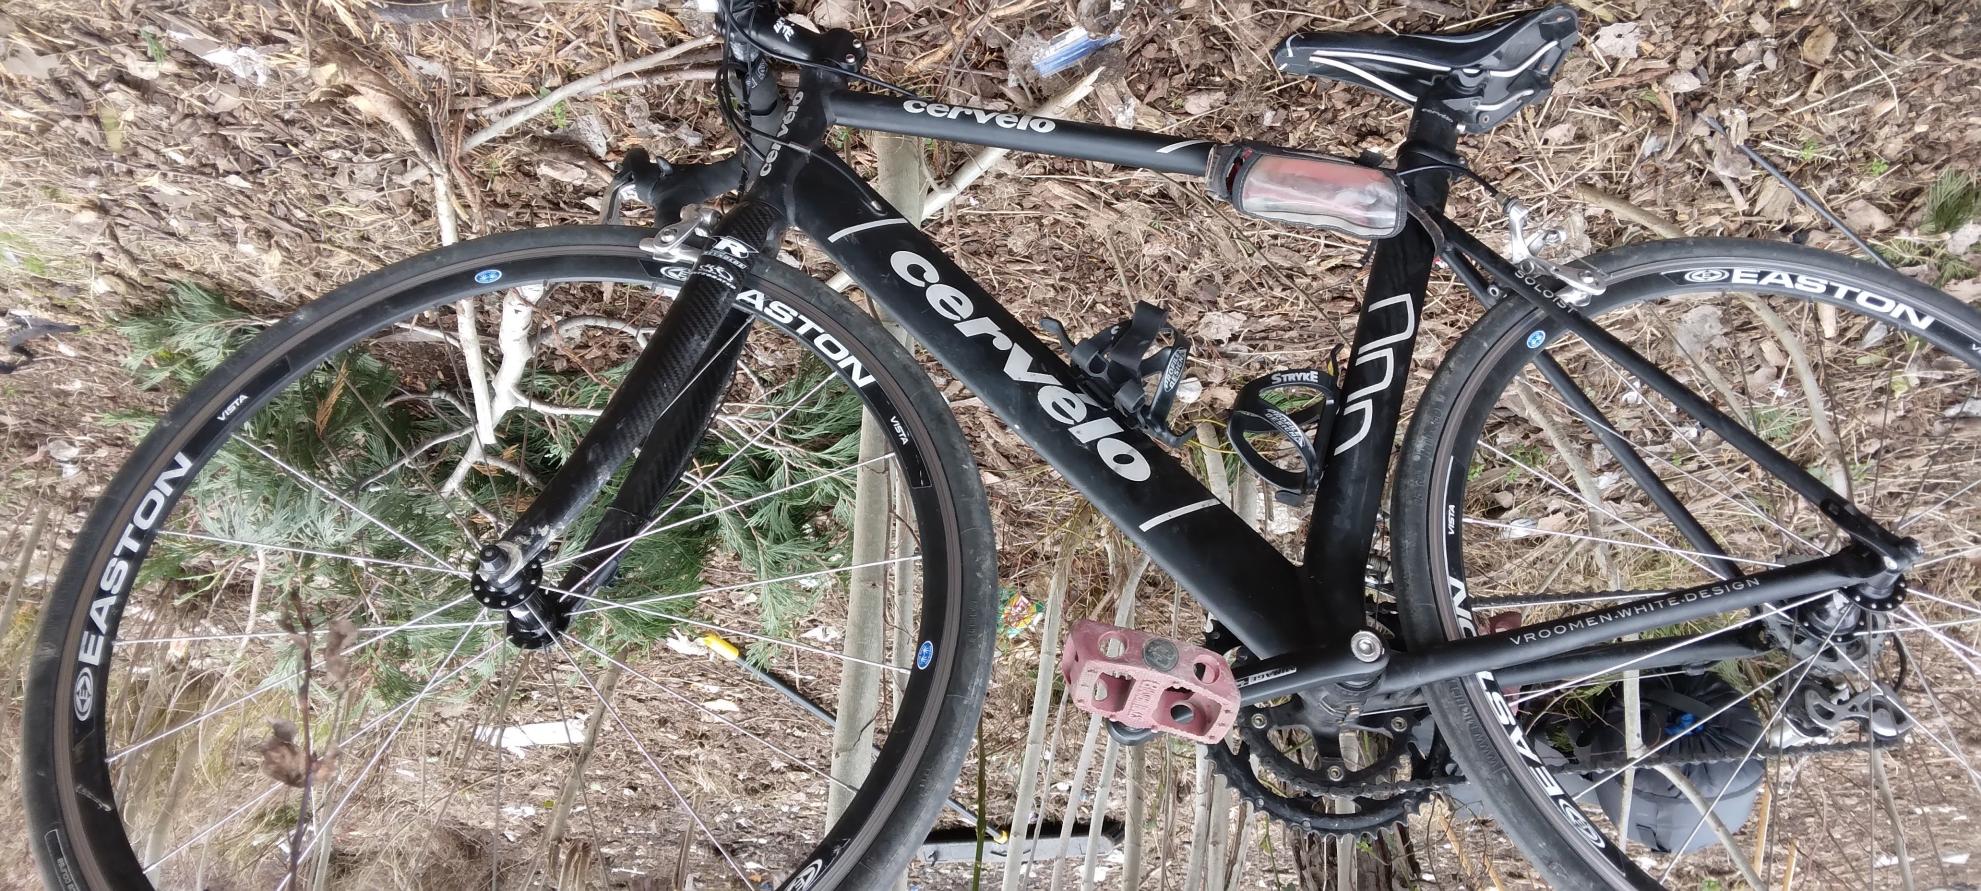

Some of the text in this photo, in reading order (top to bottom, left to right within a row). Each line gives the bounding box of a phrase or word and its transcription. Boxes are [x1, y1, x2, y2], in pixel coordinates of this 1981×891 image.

[1514, 269, 1578, 313] SOLOIST
[1731, 267, 1936, 330] EASTON
[735, 289, 876, 388] ASTON
[1271, 370, 1319, 384] STRYKE
[216, 394, 249, 421] VISTA
[890, 415, 909, 446] VISTA
[1448, 504, 1456, 535] VISTA
[77, 451, 193, 666] EASTON
